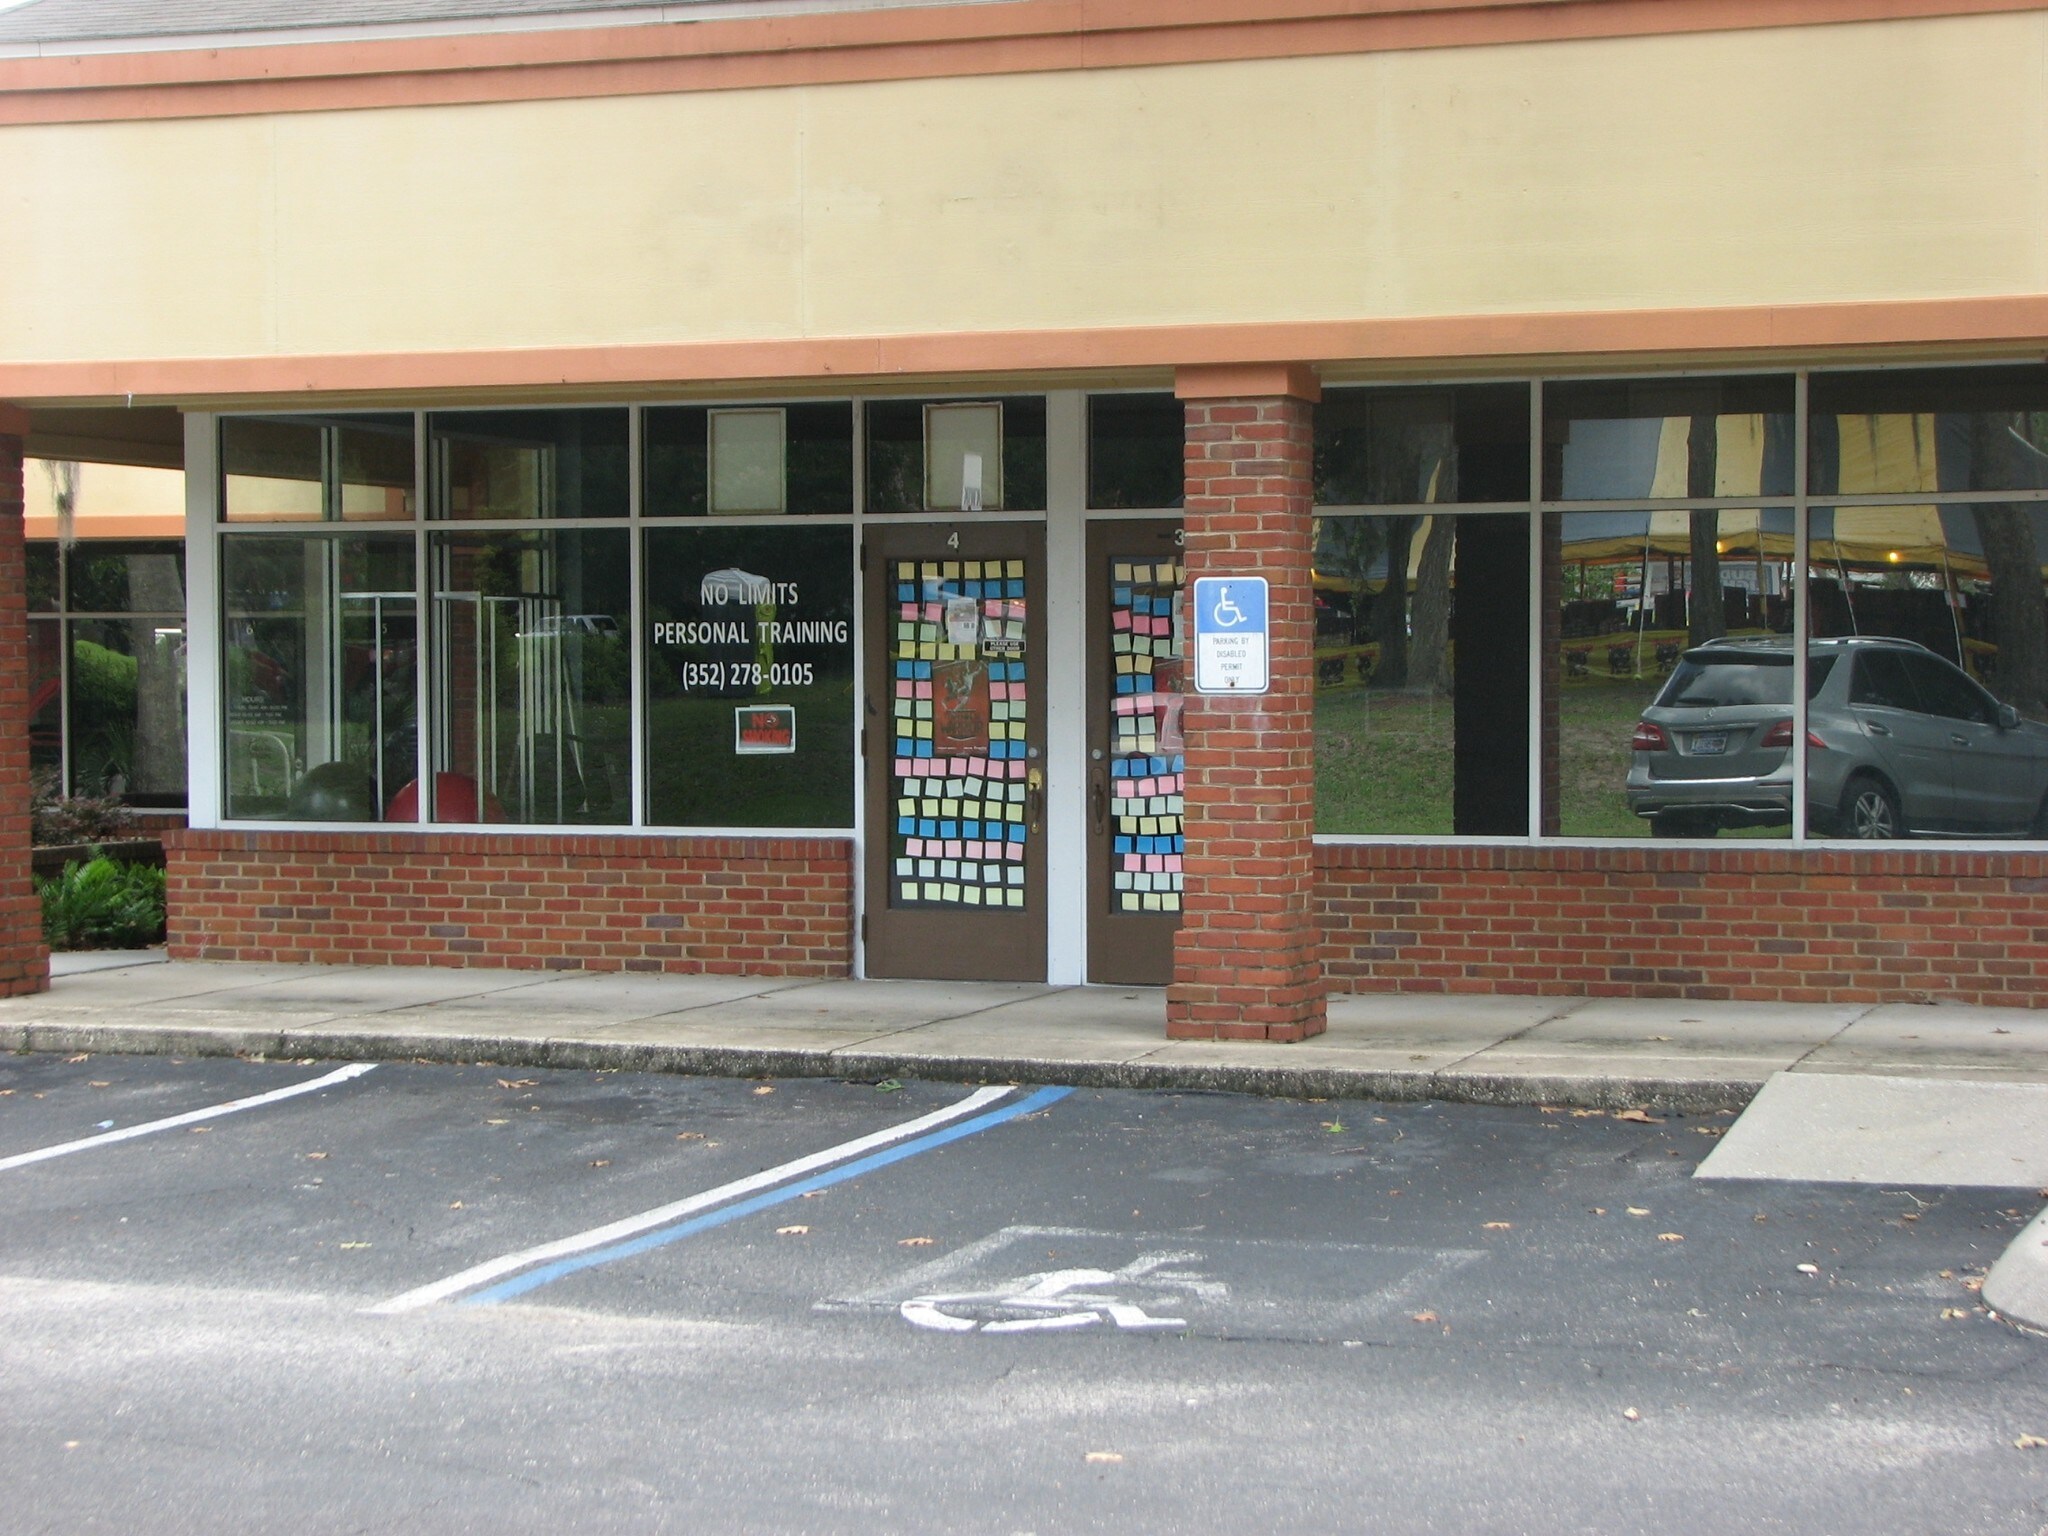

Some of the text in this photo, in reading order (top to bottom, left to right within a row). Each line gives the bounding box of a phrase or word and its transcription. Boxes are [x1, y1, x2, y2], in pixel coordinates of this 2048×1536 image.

[947, 531, 960, 549] 4
[1174, 529, 1184, 546] 3
[701, 582, 799, 605] NO LIMITS
[654, 621, 848, 644] PERSONAL TRAINING
[1212, 637, 1250, 645] PARKING BY
[1216, 650, 1247, 658] DISABLED
[682, 661, 813, 690] (352) 278-0105
[1220, 663, 1243, 671] PERMIT
